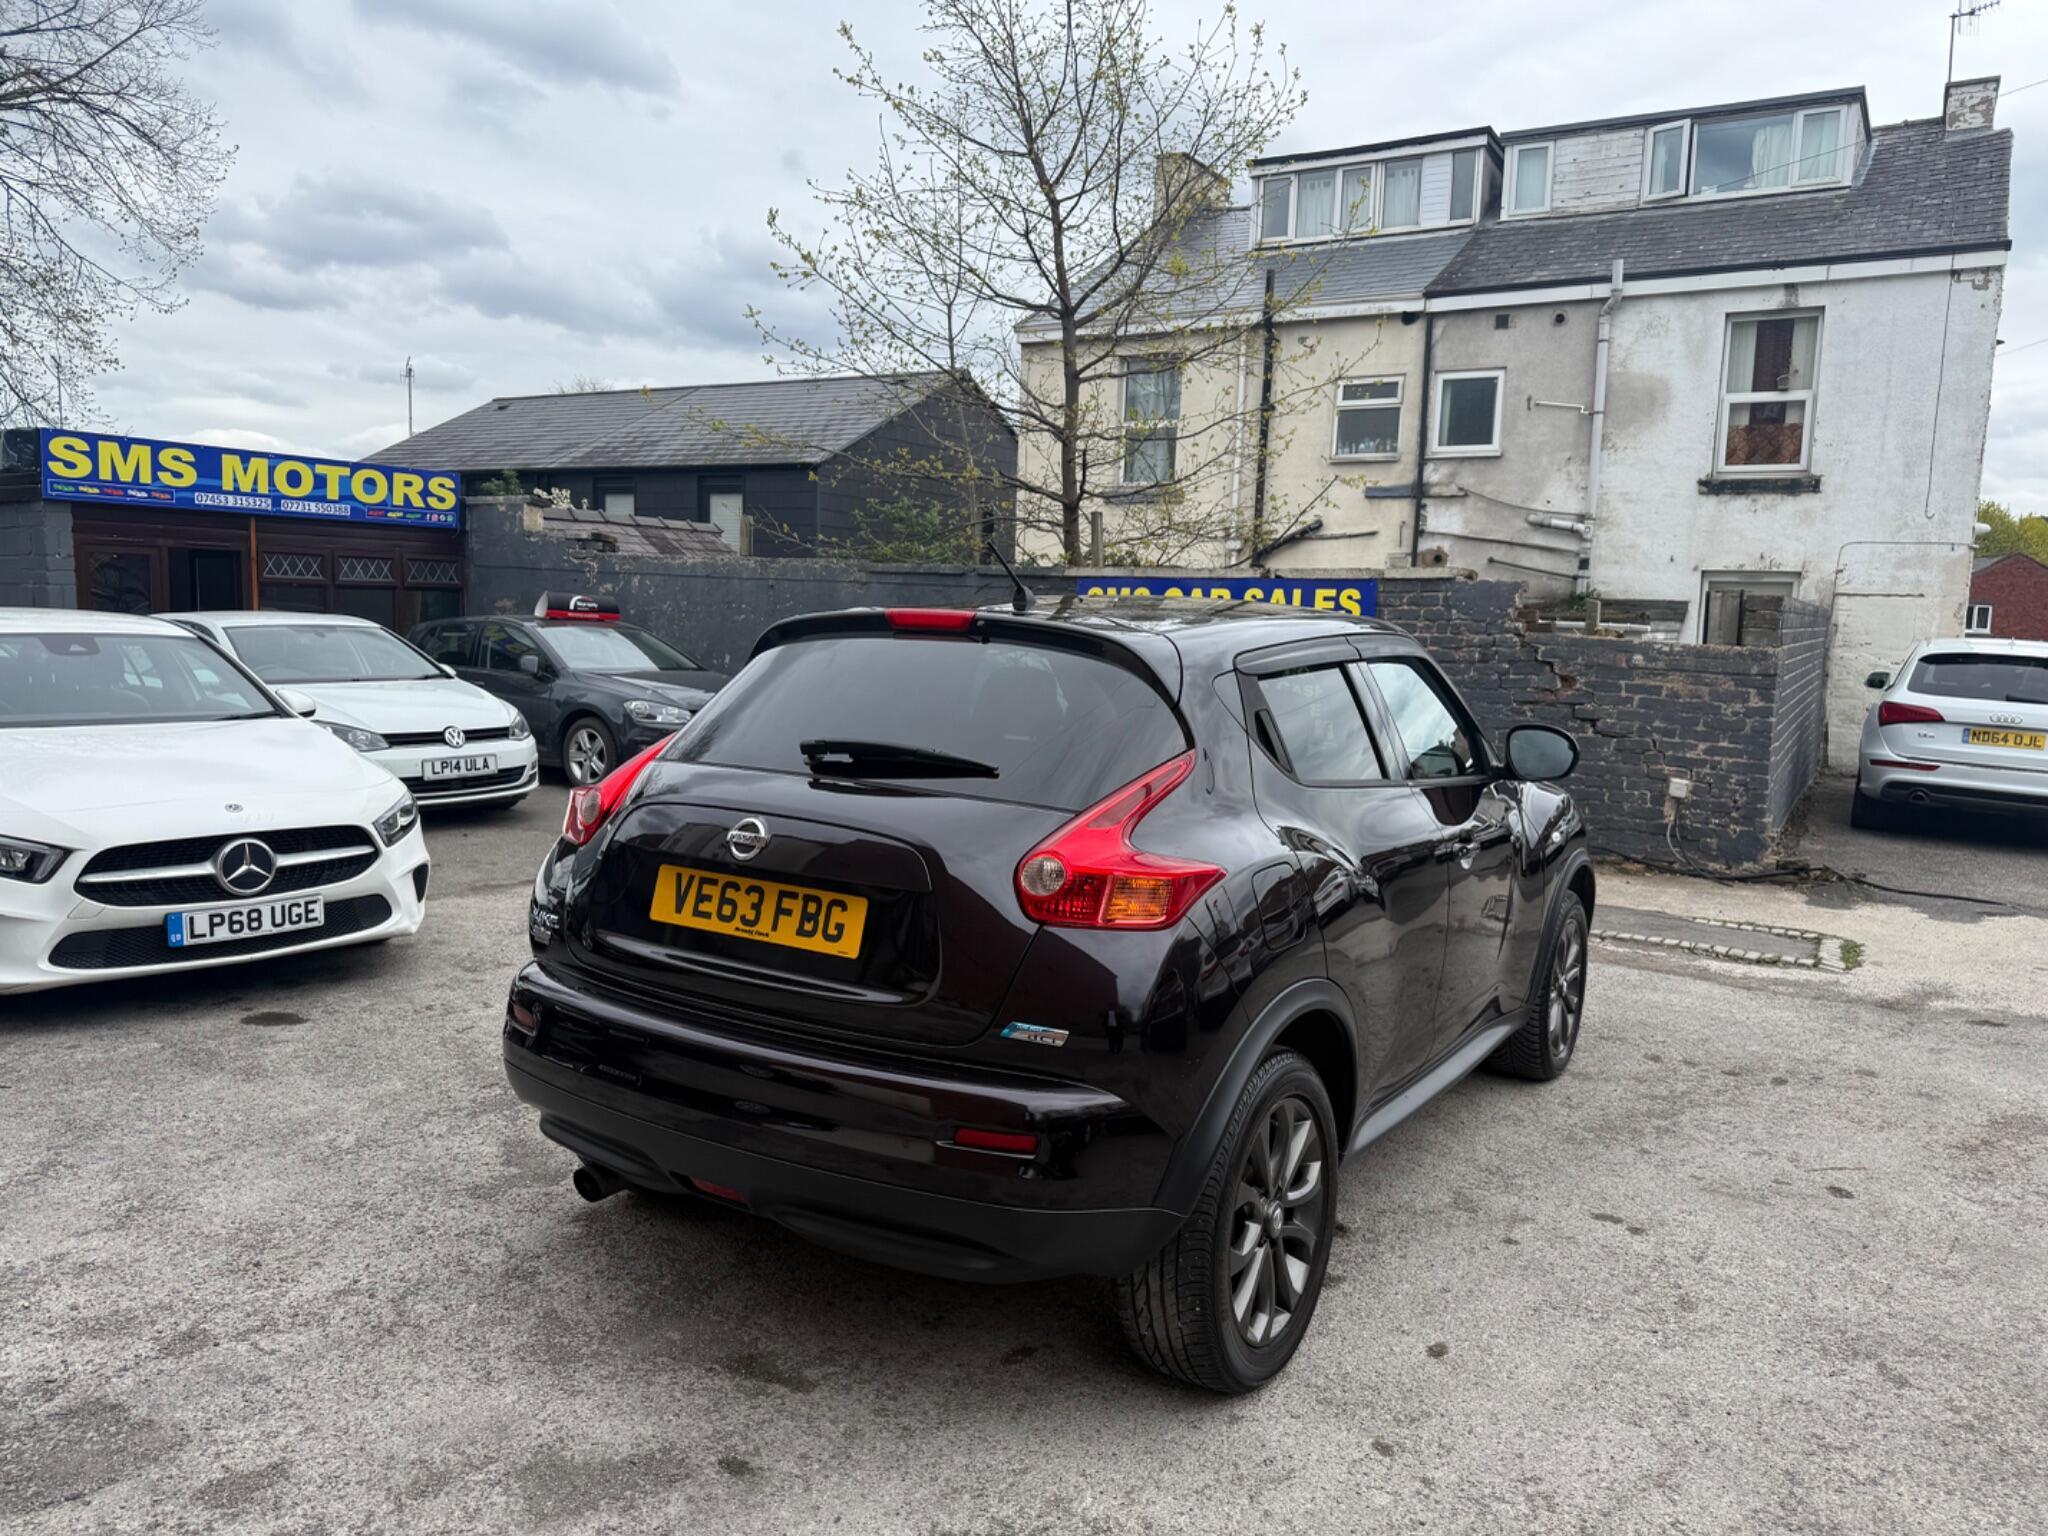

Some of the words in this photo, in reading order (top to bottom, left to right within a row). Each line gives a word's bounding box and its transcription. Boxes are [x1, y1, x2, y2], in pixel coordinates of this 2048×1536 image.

[47, 436, 198, 487] SMS
[221, 453, 457, 510] MOTORS
[432, 759, 461, 775] LP14
[465, 756, 490, 772] ULA
[188, 908, 263, 940] LP68
[271, 900, 319, 928] UGE
[674, 872, 765, 928] VE63
[771, 889, 849, 944] FBG
